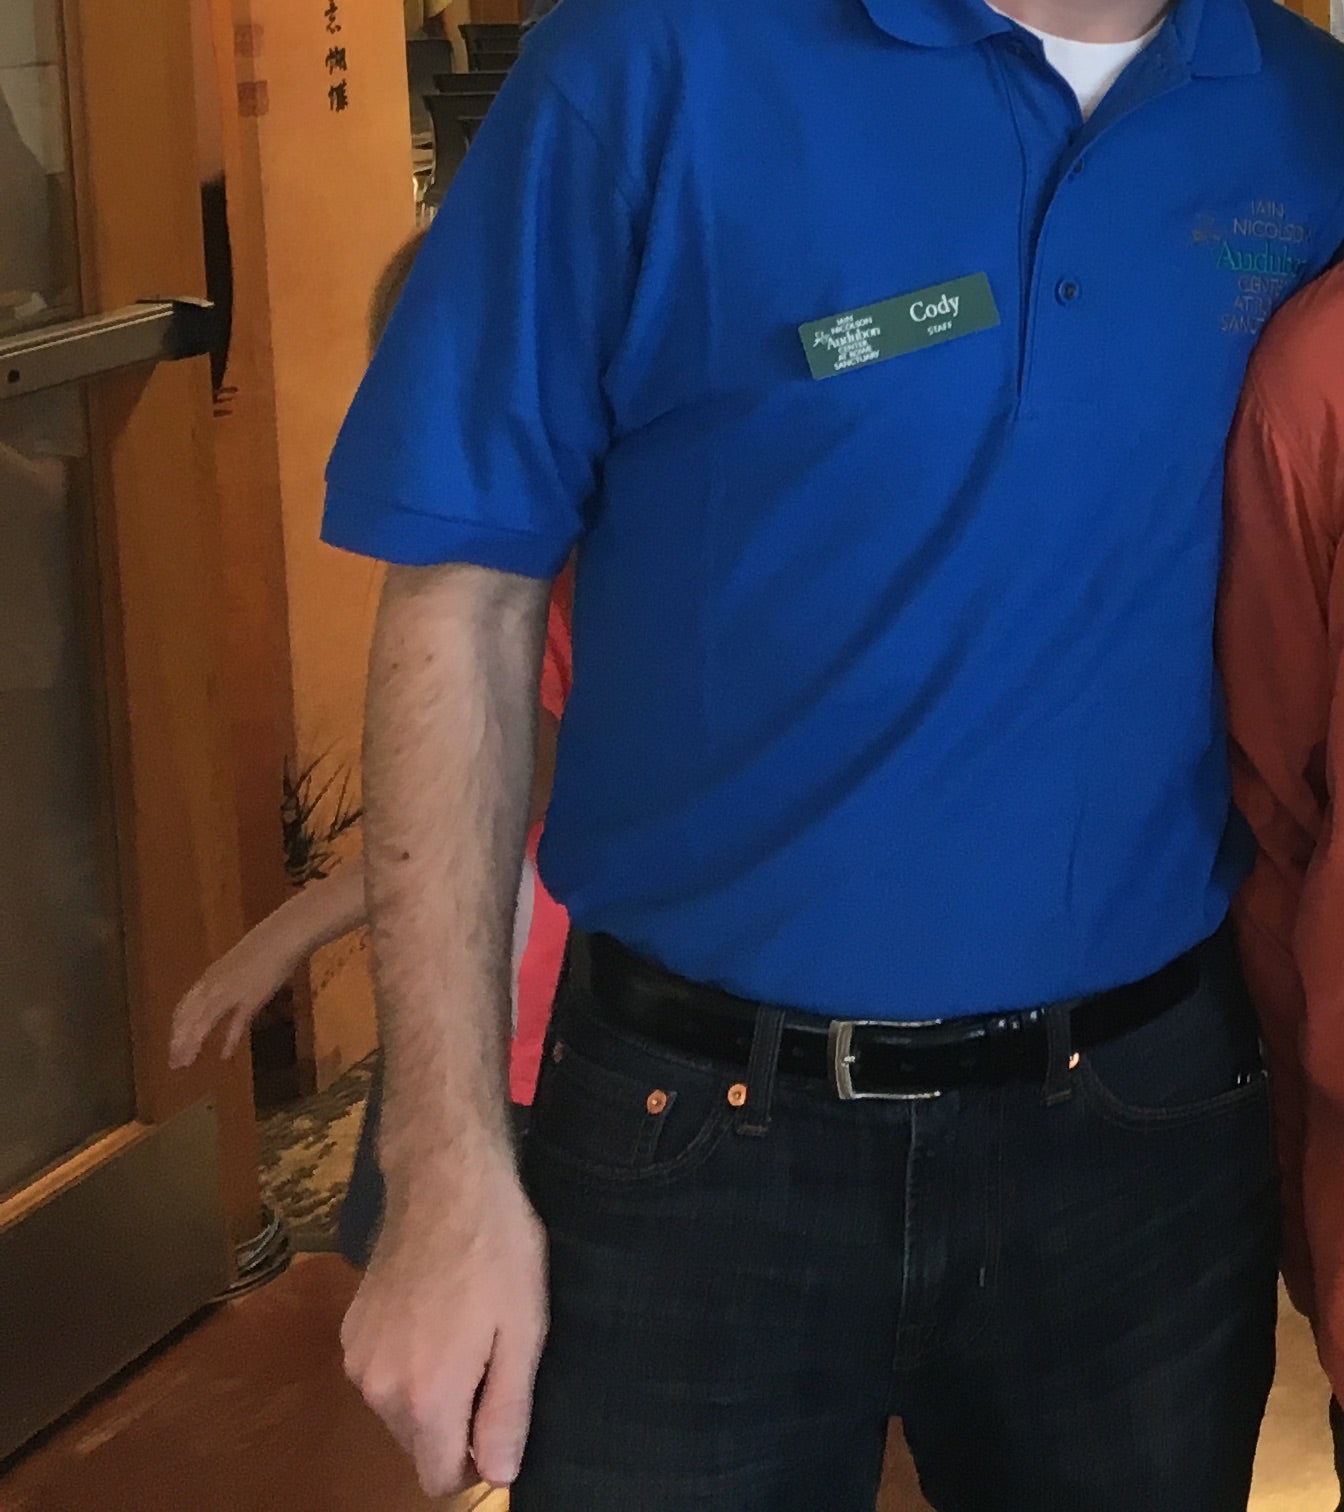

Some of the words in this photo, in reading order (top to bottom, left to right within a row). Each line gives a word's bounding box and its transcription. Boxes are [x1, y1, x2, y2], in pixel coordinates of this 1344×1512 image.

[909, 294, 960, 322] Cody
[827, 327, 880, 350] Audubon
[927, 321, 952, 336] STAFF
